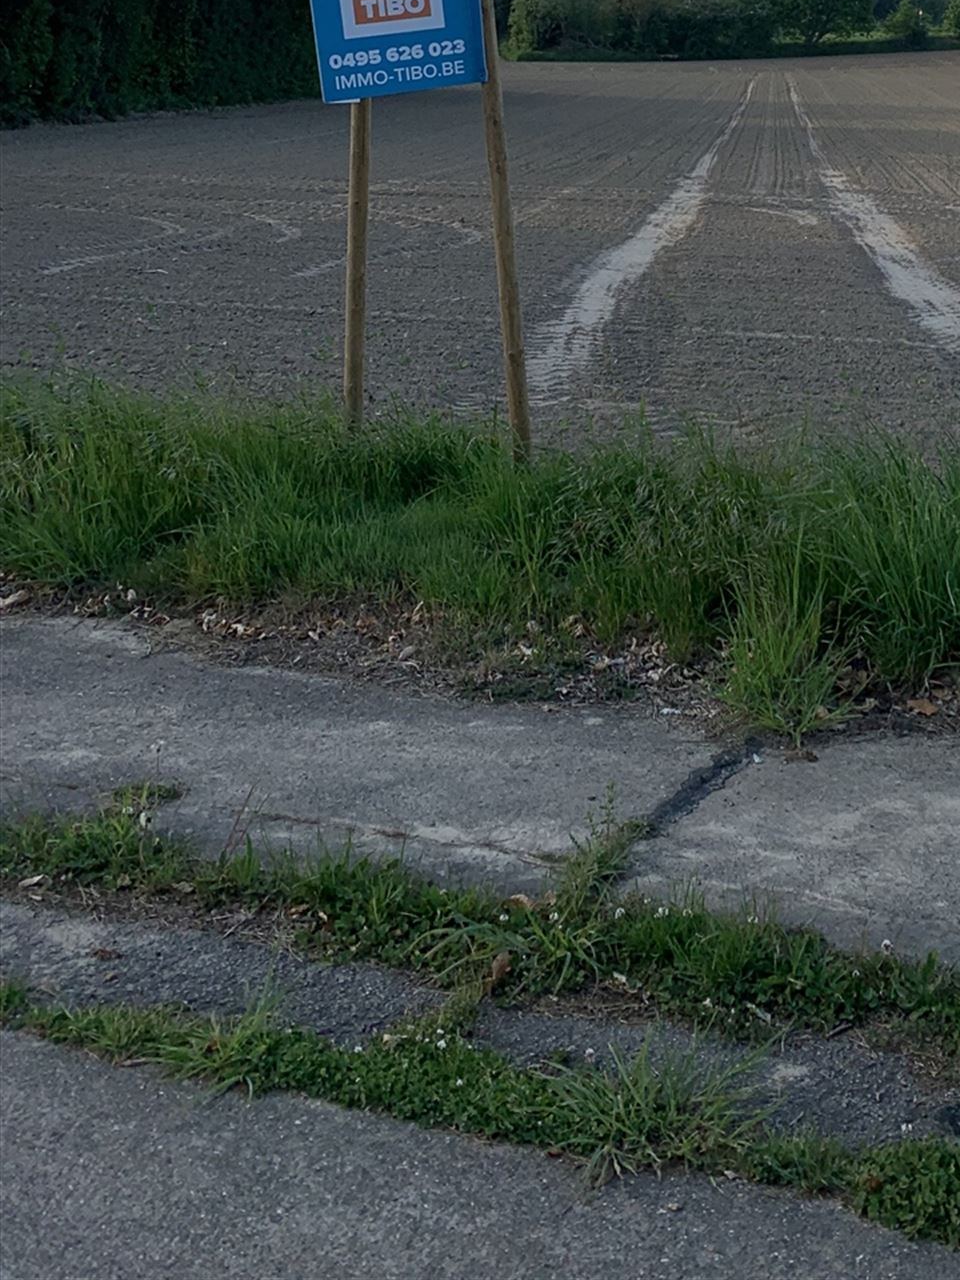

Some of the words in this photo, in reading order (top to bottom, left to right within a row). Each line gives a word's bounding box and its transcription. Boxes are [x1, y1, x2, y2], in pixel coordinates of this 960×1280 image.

[329, 49, 382, 70] 0495
[386, 44, 424, 63] 626
[429, 39, 466, 56] 023
[335, 60, 465, 90] IMMO-TIBO.BE
